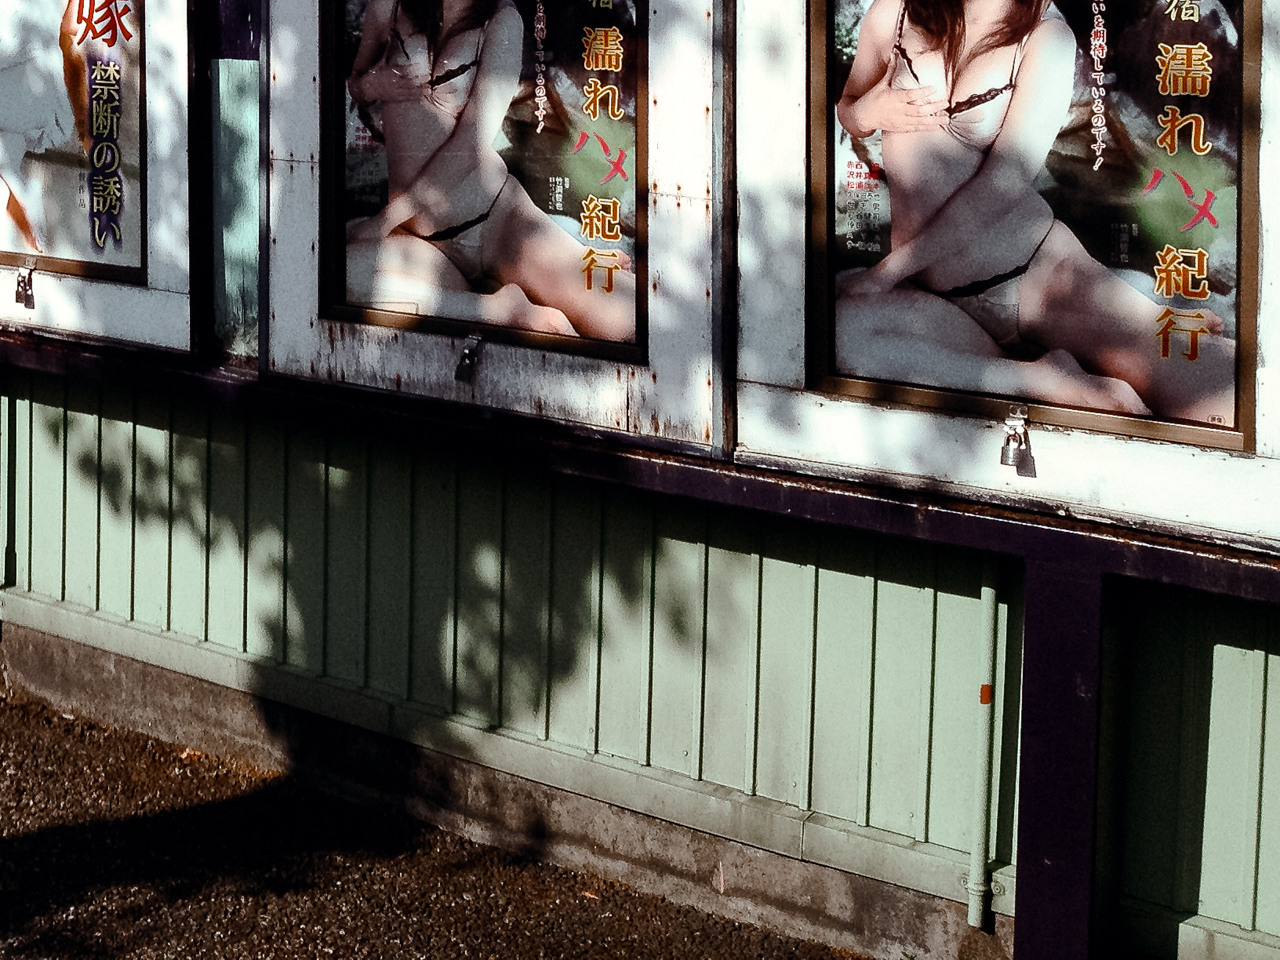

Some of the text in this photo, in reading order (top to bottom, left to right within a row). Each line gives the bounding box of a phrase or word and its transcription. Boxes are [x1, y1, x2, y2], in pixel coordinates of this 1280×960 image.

[90, 60, 122, 250] 禁断の誘い
[572, 25, 630, 294] 濡れハメ紀行
[1142, 41, 1221, 363] 濡れハメ紀行
